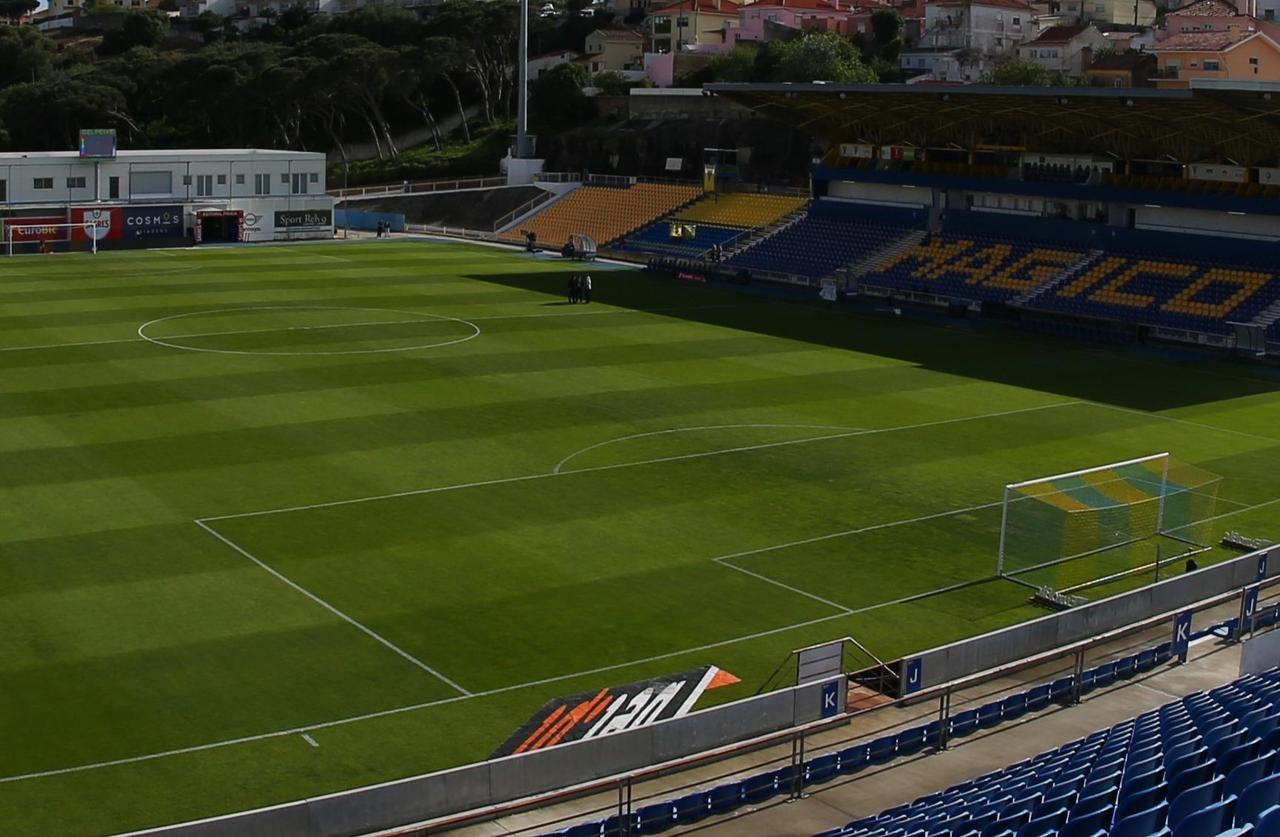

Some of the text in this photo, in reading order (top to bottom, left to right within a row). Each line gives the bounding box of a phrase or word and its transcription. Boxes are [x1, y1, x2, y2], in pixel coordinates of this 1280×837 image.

[1259, 560, 1265, 573] J
[1246, 598, 1255, 617] J
[1176, 622, 1189, 642] K
[909, 668, 918, 684] J
[824, 691, 836, 708] K
